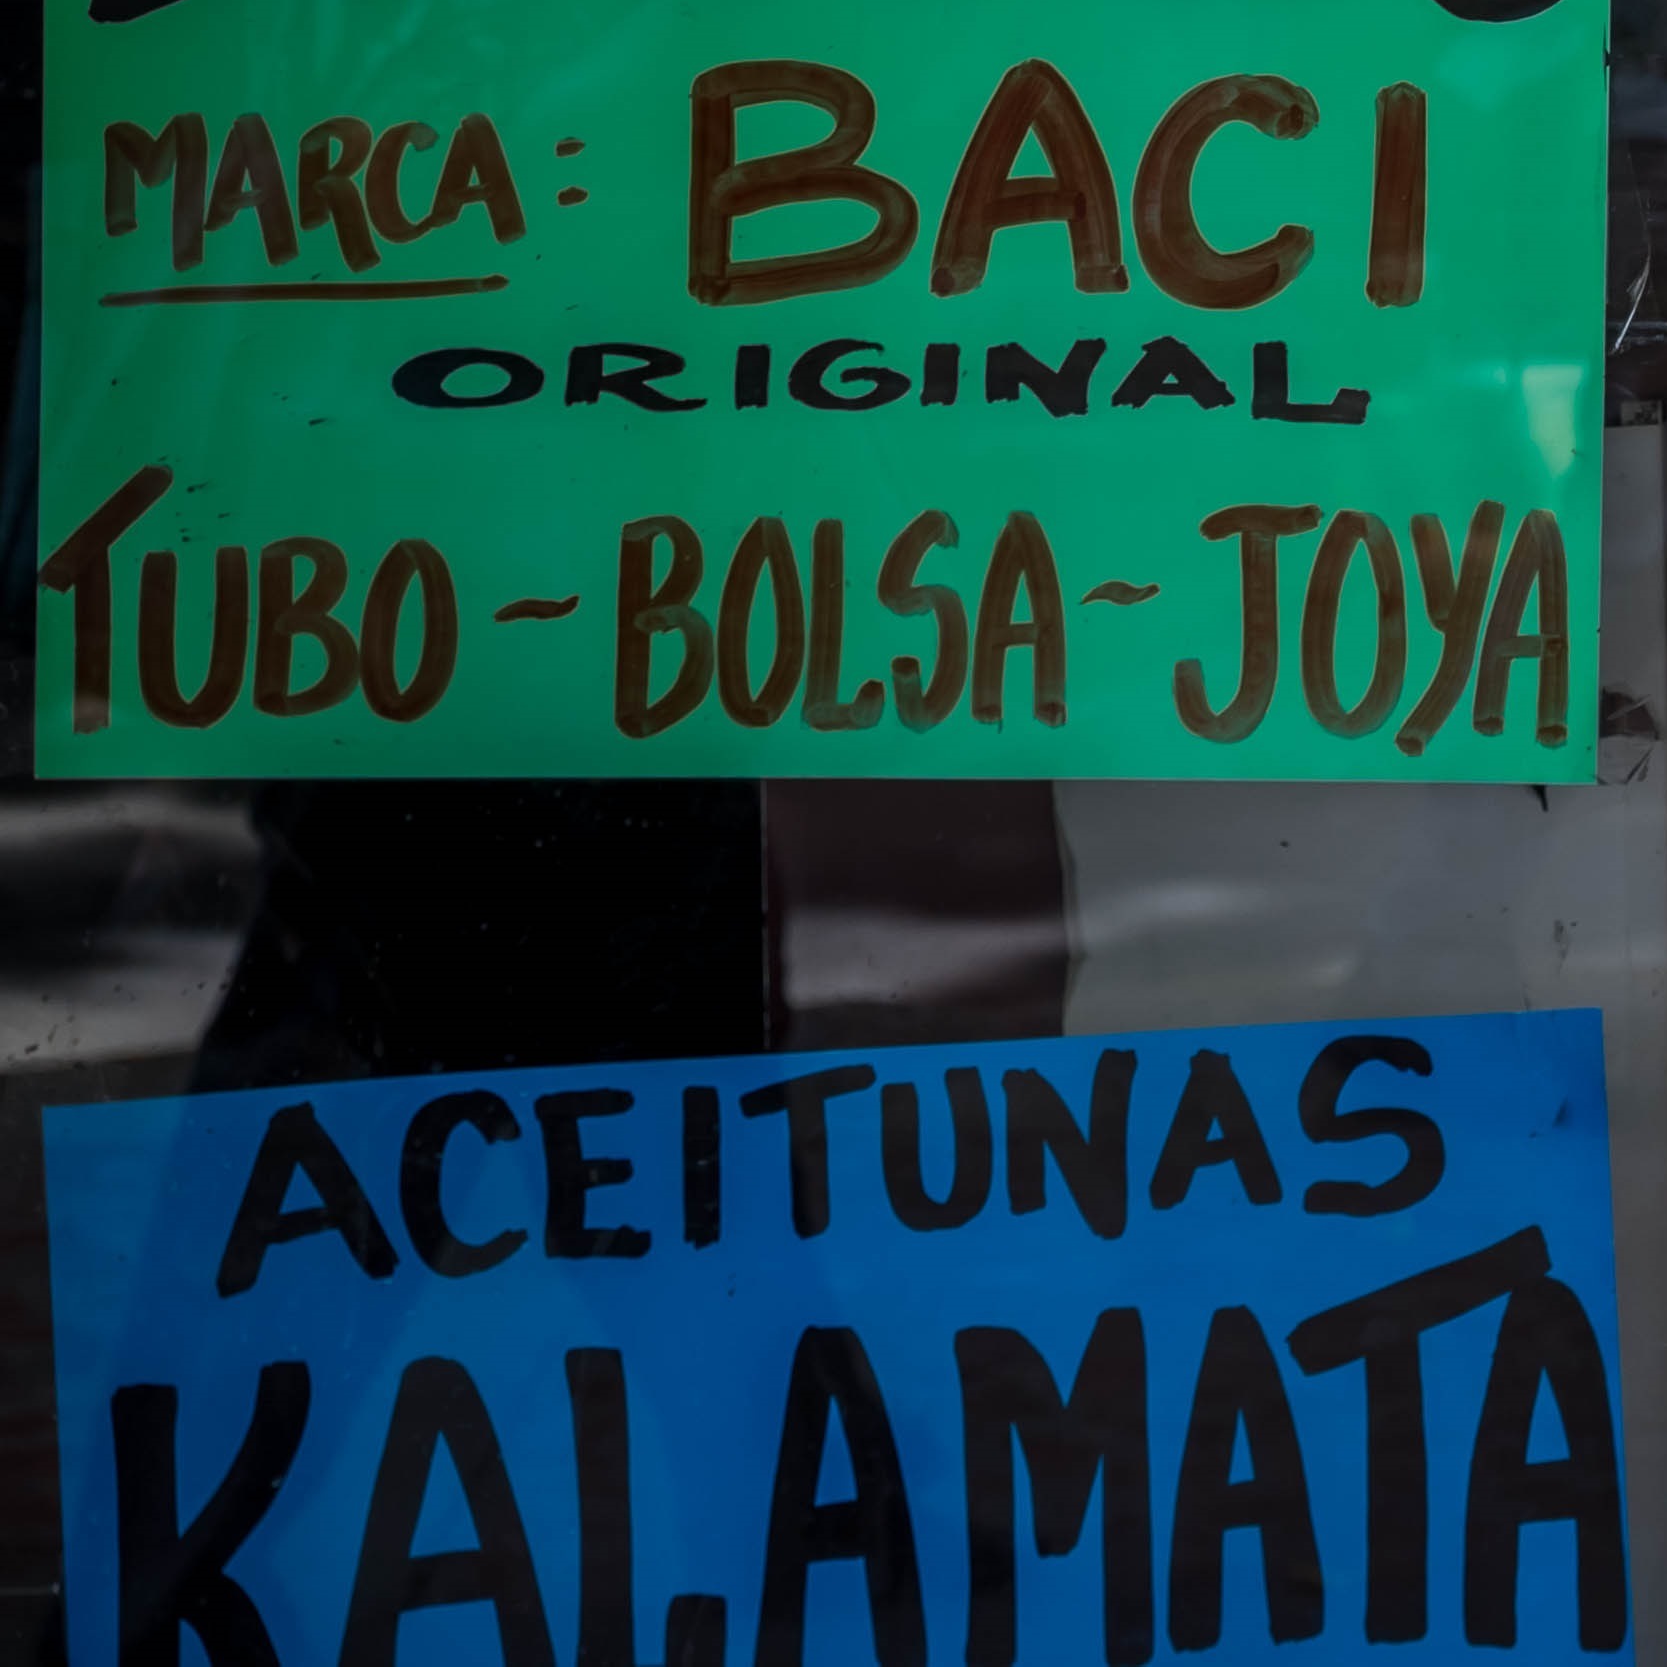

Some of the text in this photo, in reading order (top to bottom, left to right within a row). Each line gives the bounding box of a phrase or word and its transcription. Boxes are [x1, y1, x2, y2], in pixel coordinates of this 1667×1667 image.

[103, 57, 1430, 310] MARCA: BACI
[391, 336, 1368, 422] ORIGINAL
[37, 463, 1570, 758] TUBO BOLSA JOYA
[216, 1036, 1446, 1299] ACEITUNAS
[111, 1225, 1632, 1667] KALAMATA
